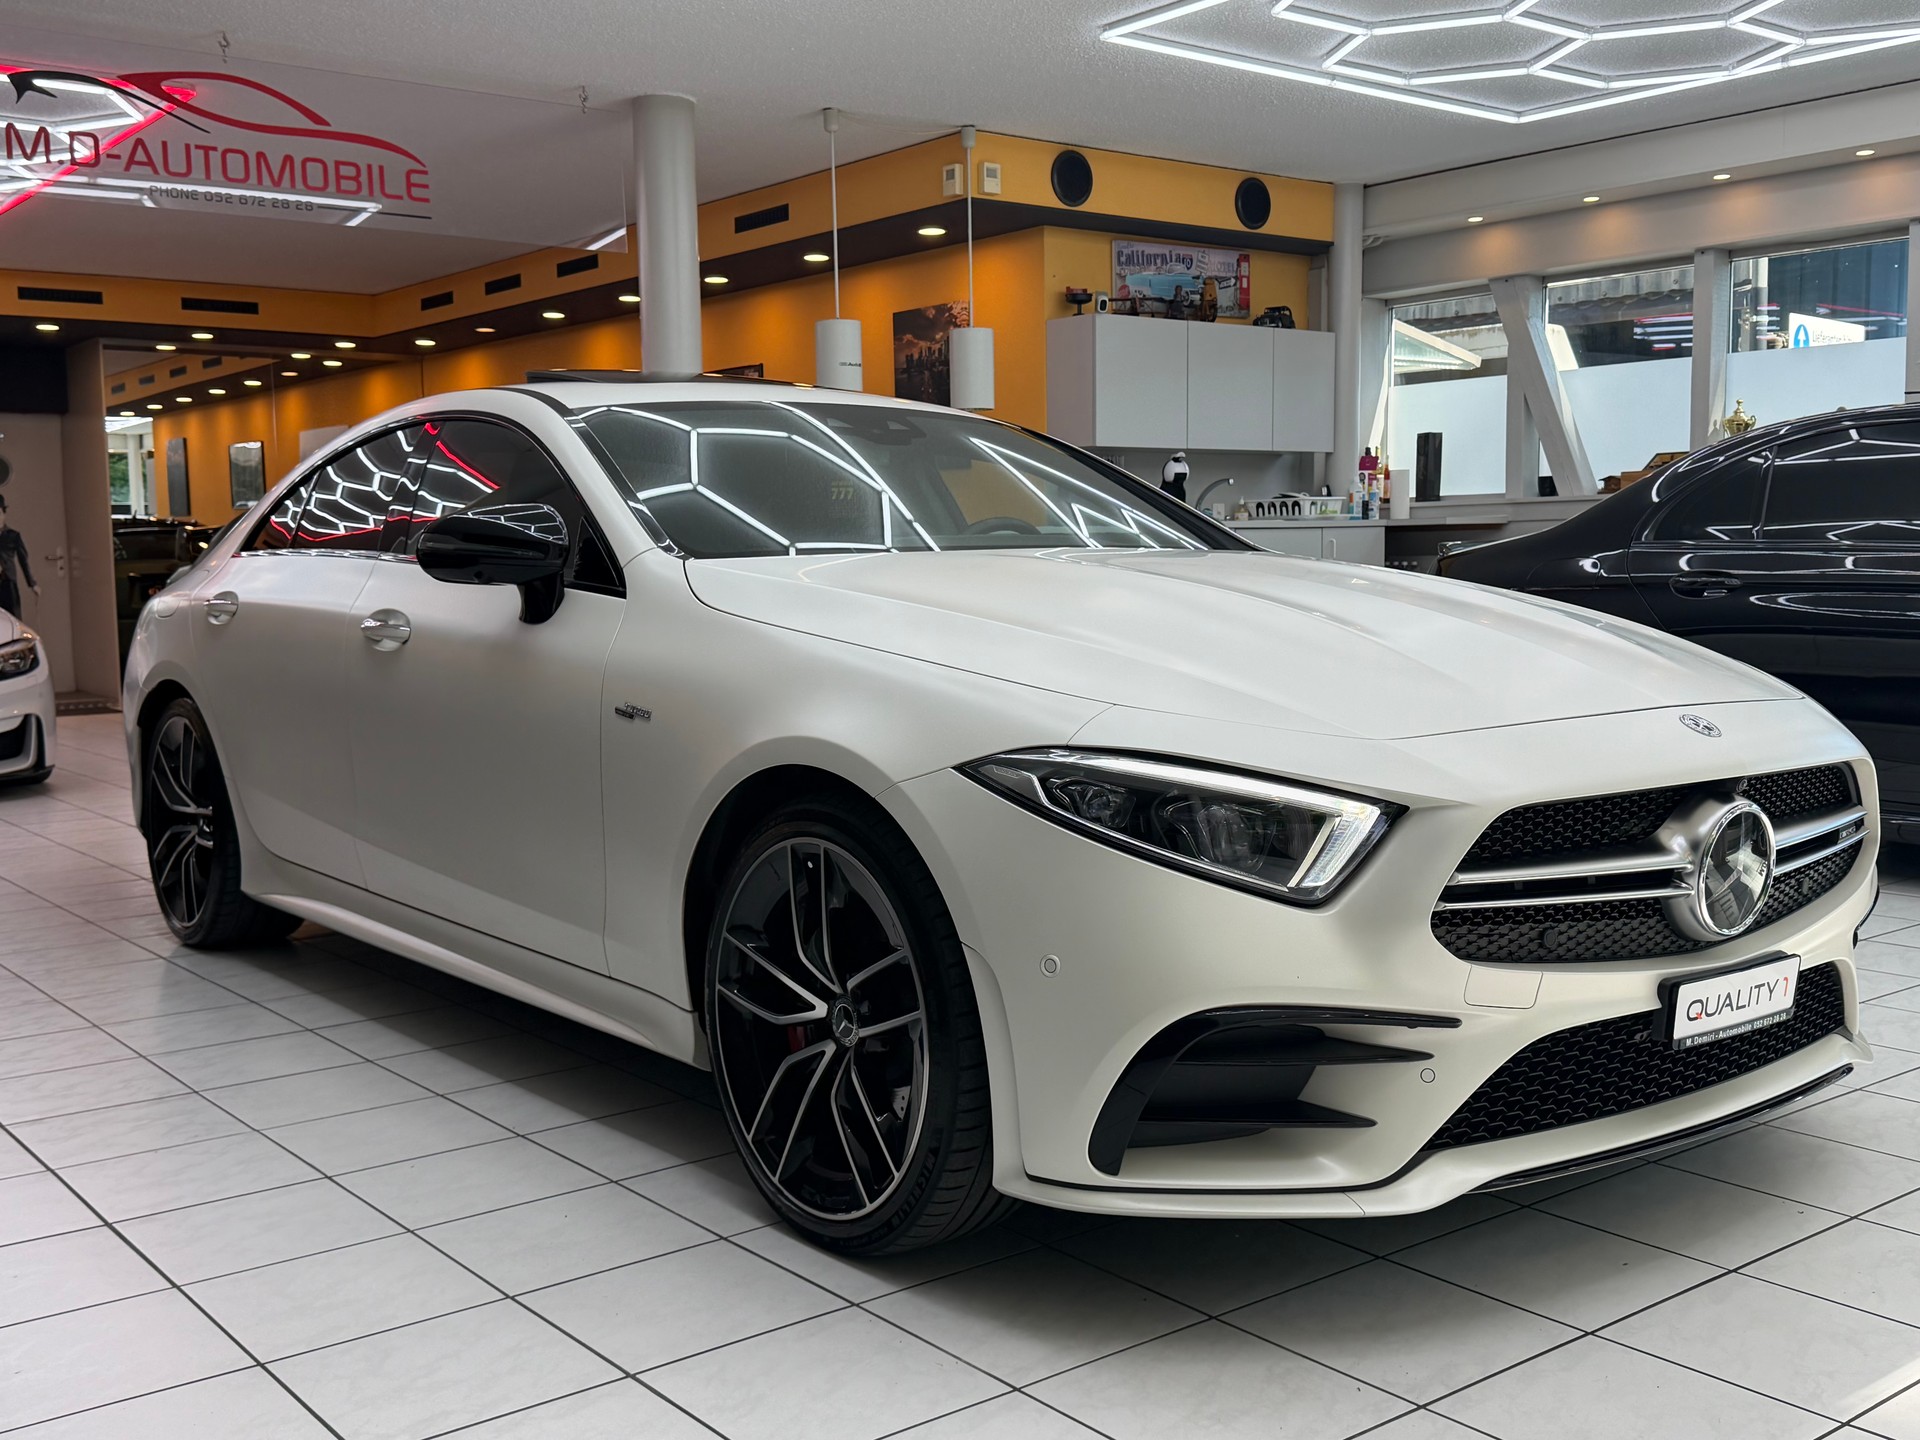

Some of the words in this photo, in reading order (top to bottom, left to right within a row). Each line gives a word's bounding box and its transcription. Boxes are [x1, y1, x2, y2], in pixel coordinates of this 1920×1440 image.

[149, 185, 199, 201] PHONE
[203, 191, 233, 204] 052
[239, 195, 266, 208] 672
[271, 198, 291, 211] 28
[294, 200, 315, 212] 28
[1116, 249, 1183, 267] California
[1686, 978, 1780, 1022] QUALITY
[1718, 1023, 1752, 1039] Automobile
